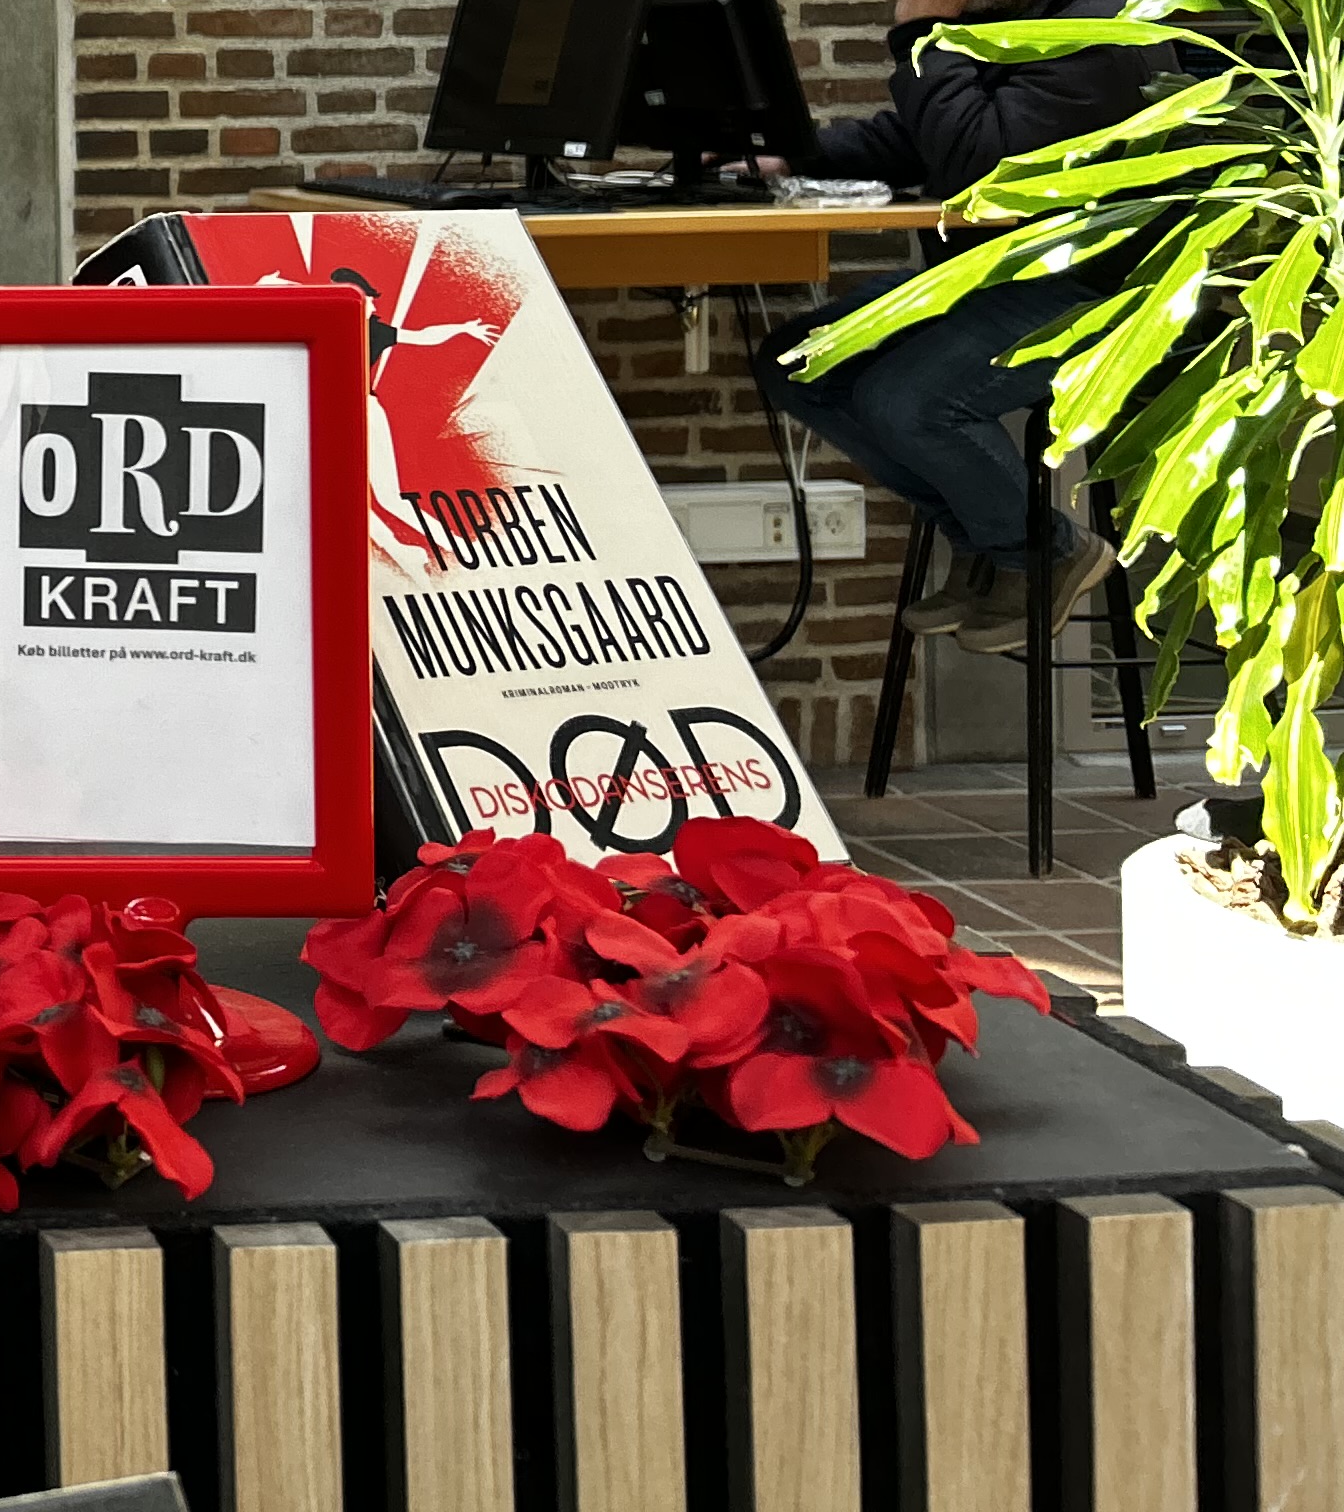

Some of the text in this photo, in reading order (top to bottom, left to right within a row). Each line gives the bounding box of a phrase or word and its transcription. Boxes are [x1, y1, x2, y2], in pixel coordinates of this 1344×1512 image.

[400, 483, 598, 571] TORBEN
[40, 574, 239, 625] KRAFT
[382, 575, 711, 679] MUNKSGAARD
[17, 644, 257, 663] Køb billetter på www.ord-kraft.dk
[501, 683, 585, 699] KRIMINALROMAN
[418, 706, 802, 856] DØD
[469, 758, 772, 820] DISKODANSERENS
